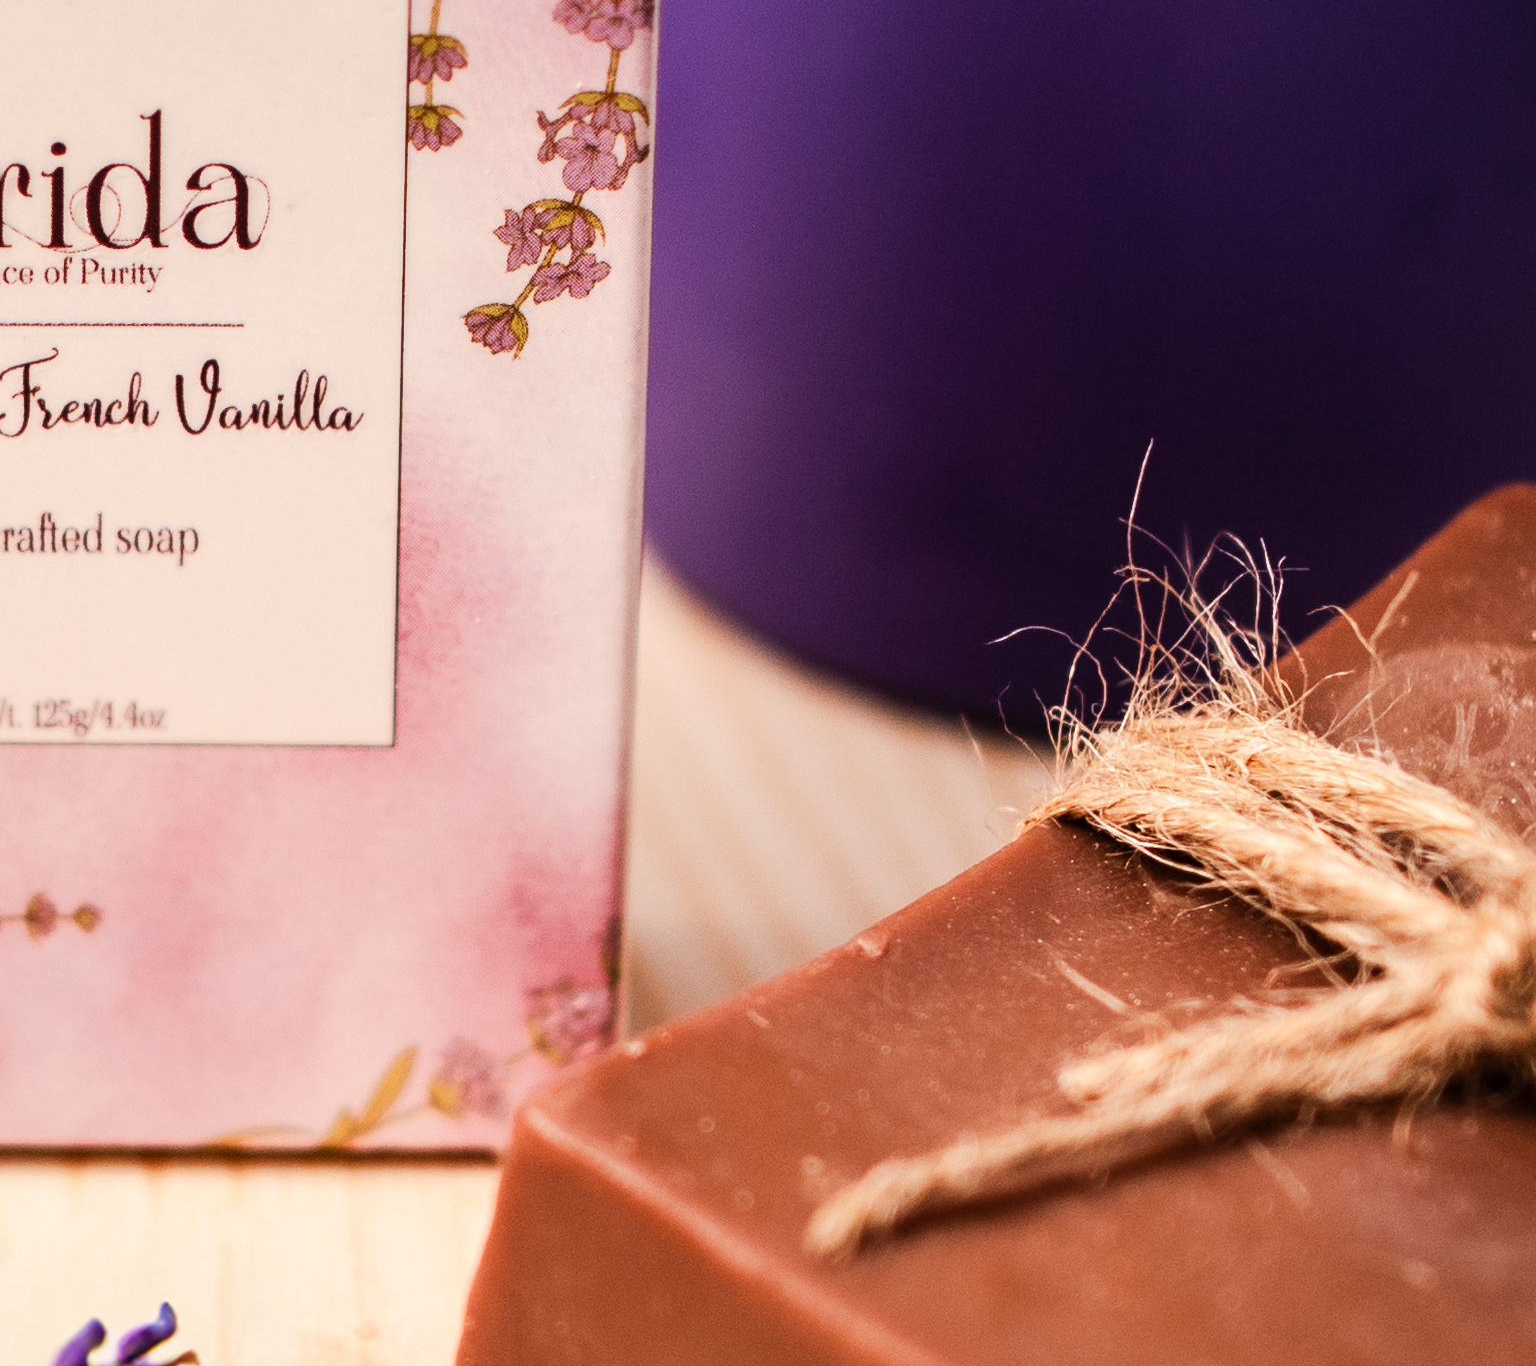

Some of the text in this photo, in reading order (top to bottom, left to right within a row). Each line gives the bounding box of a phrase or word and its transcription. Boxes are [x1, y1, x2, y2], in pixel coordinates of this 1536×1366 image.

[43, 256, 73, 285] of
[81, 257, 164, 293] Purity
[174, 358, 364, 435] Vanilla
[115, 525, 200, 567] soap
